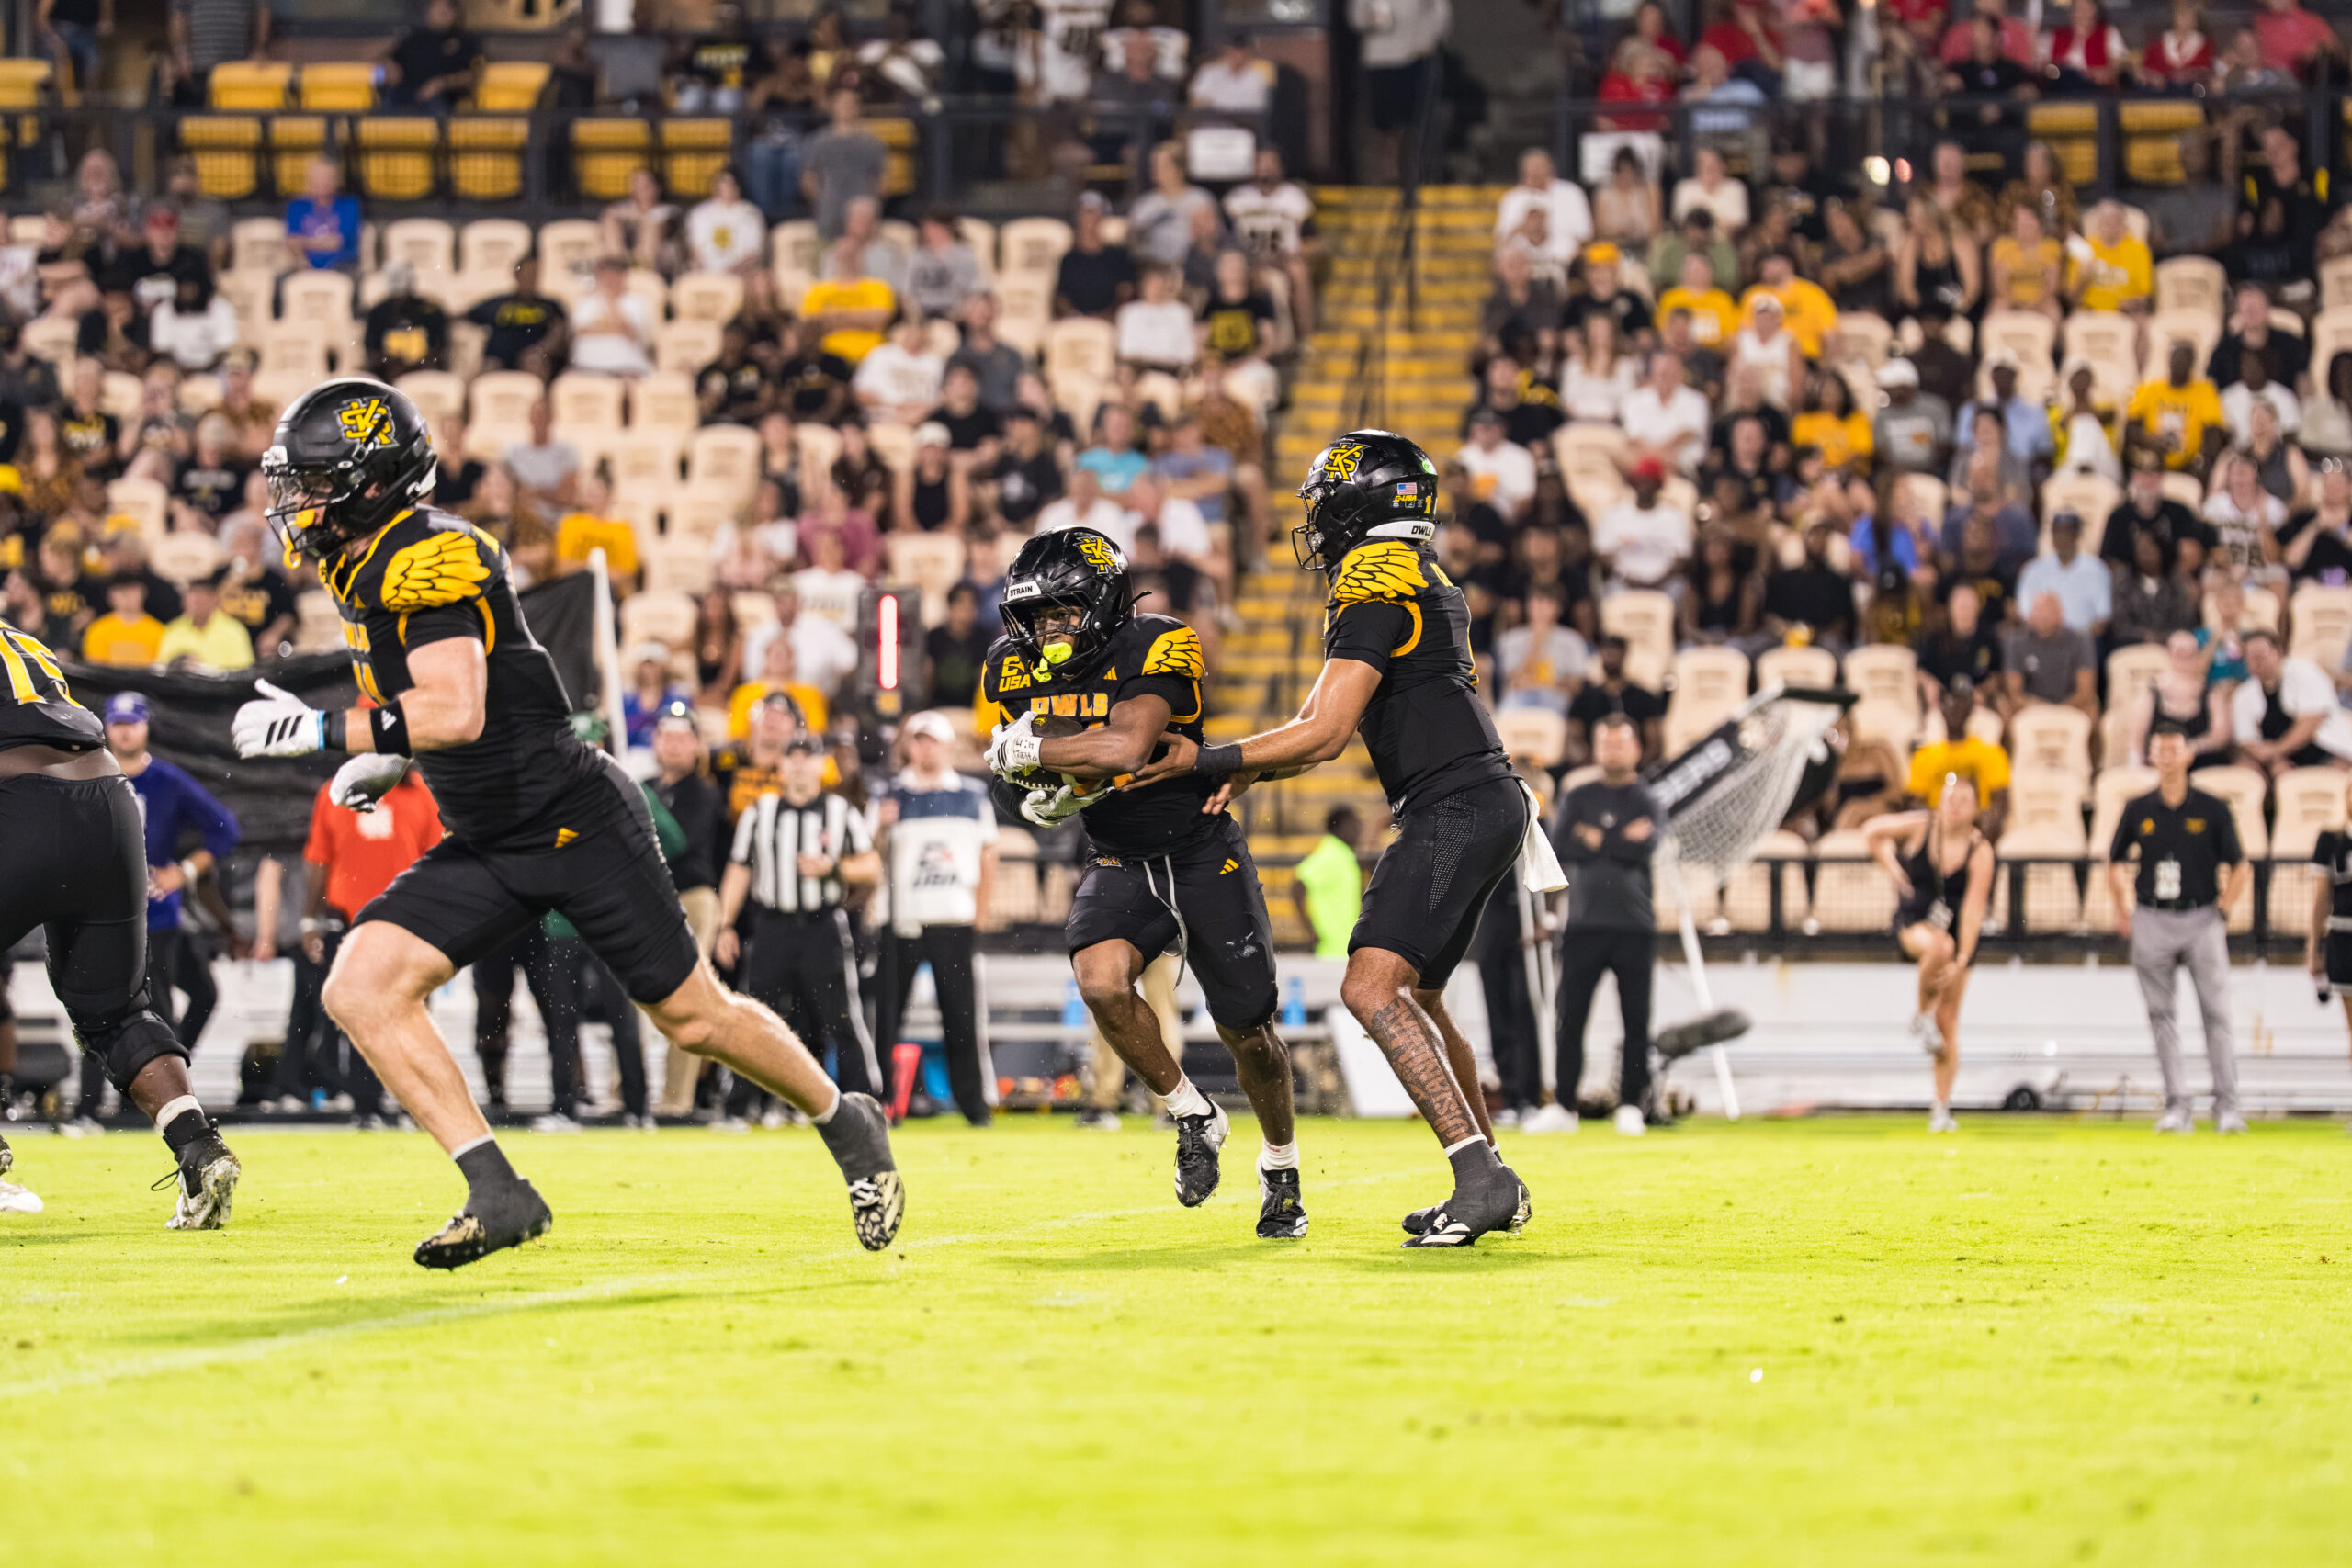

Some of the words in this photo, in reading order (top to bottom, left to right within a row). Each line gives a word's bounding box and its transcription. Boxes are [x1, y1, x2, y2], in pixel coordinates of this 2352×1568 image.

[1010, 585, 1034, 597] STRAIN
[998, 673, 1031, 693] USA
[1030, 693, 1108, 717] OWLS
